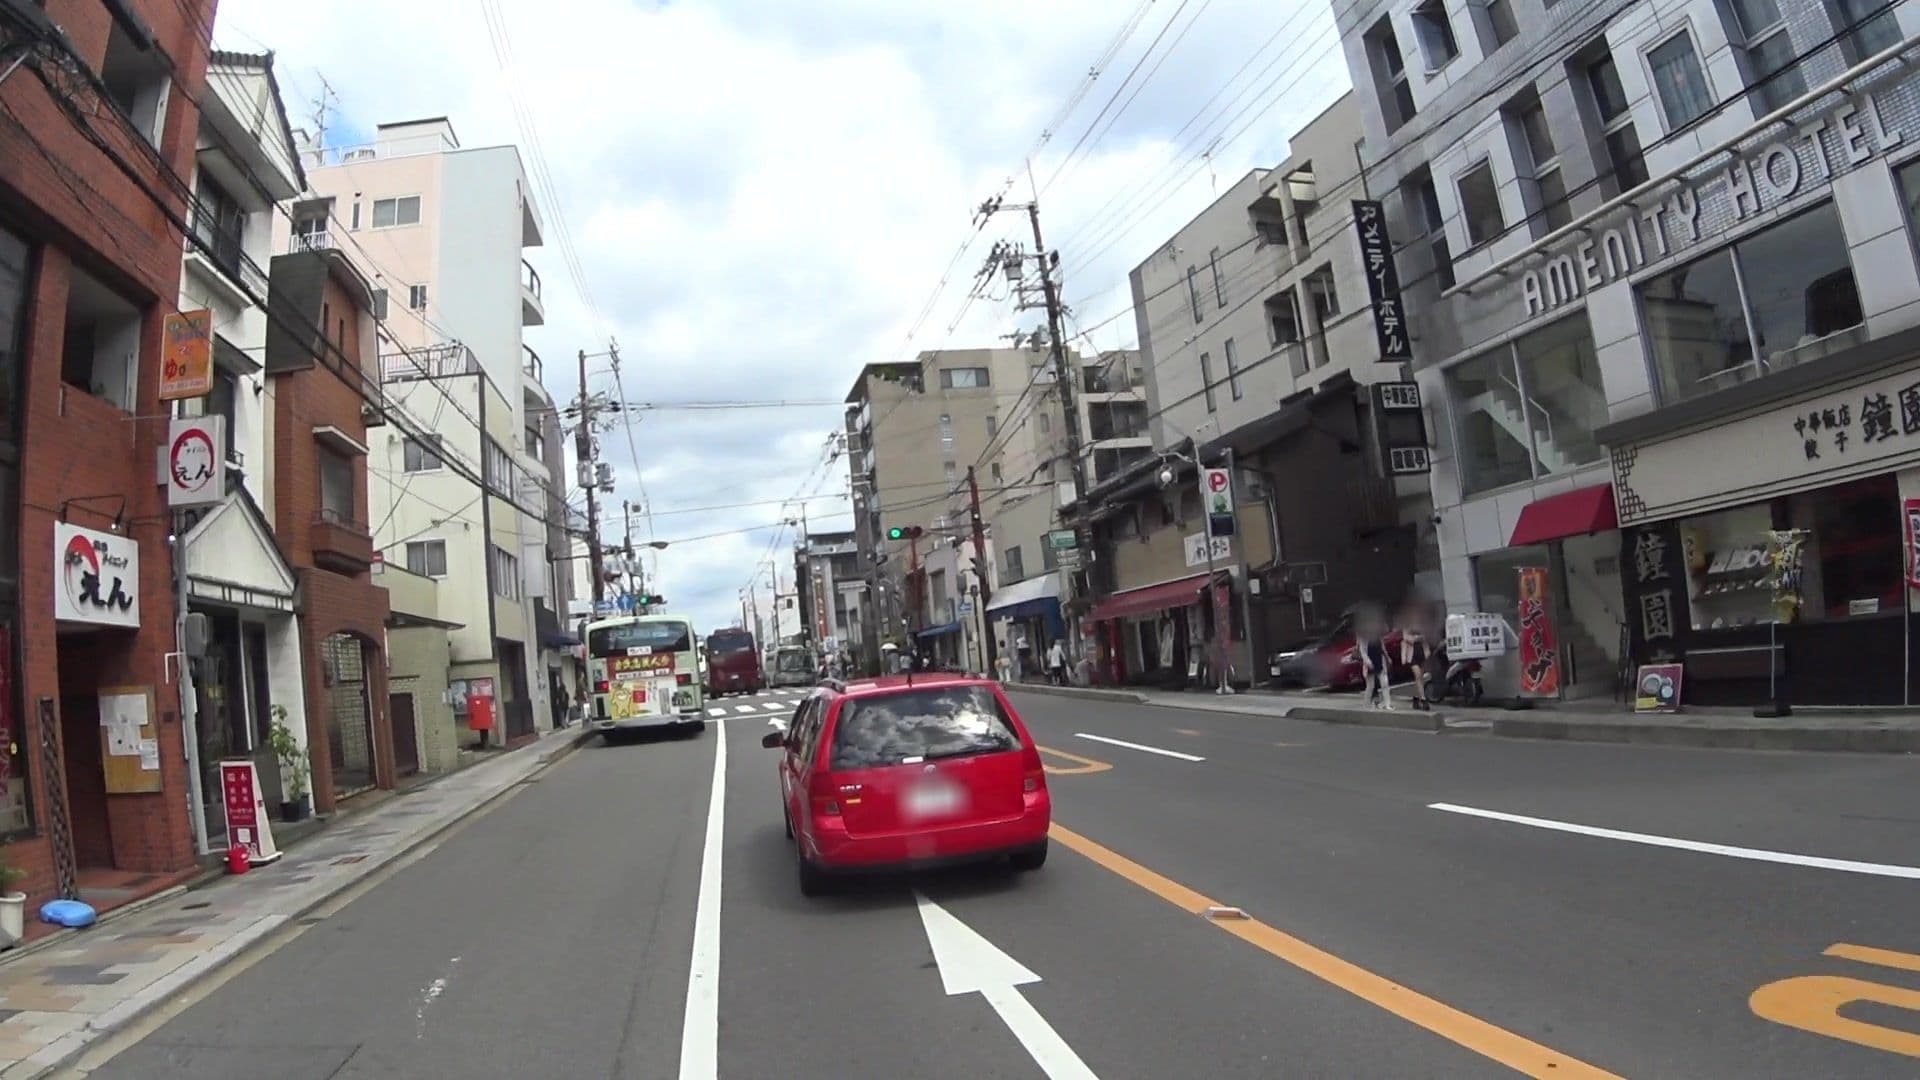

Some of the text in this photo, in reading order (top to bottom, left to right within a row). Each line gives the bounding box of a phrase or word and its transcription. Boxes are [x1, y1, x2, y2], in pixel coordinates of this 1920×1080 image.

[1360, 205, 1403, 354] アメニティーホテル
[1522, 94, 1901, 316] AMENITY HOTEL
[79, 570, 133, 611] えん
